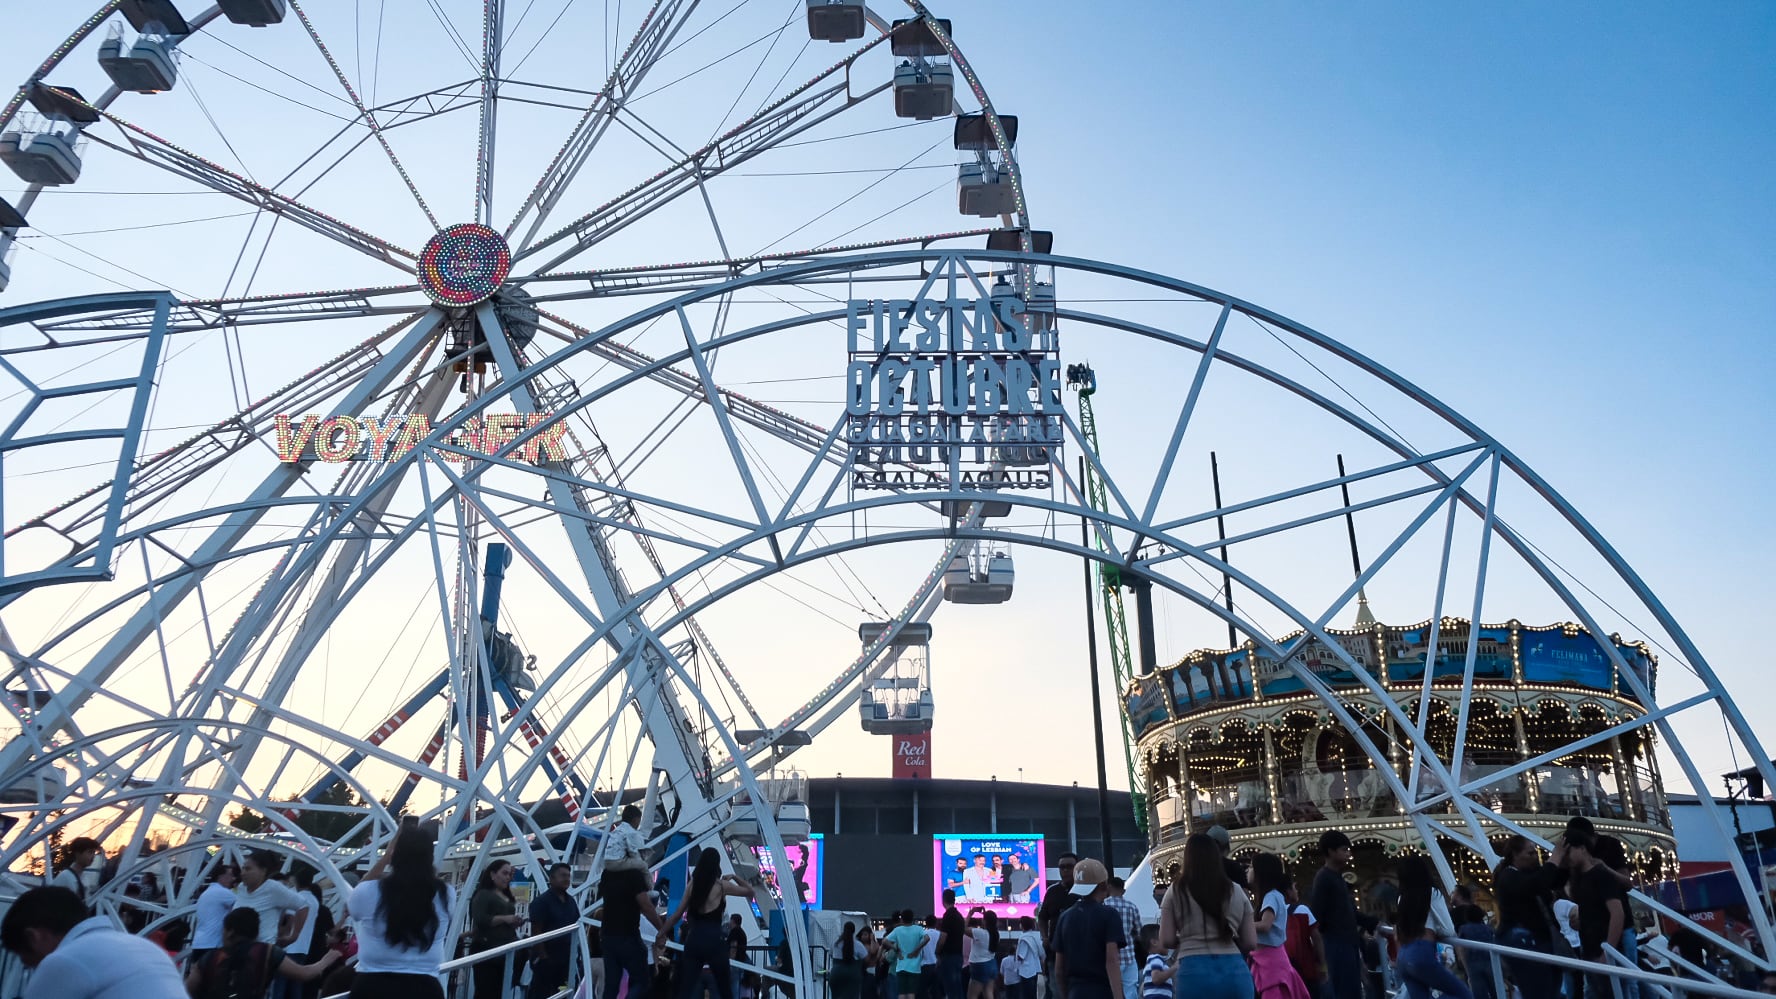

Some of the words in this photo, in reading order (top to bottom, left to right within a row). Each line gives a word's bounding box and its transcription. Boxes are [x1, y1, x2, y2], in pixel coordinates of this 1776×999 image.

[847, 298, 1026, 352] FIESTAS
[847, 359, 1062, 416] OCTUBRE
[274, 413, 567, 464] VOYAGER
[847, 421, 1063, 443] GUADALAJARA
[897, 740, 927, 756] Red
[905, 757, 925, 766] Cola
[1074, 870, 1085, 881] M
